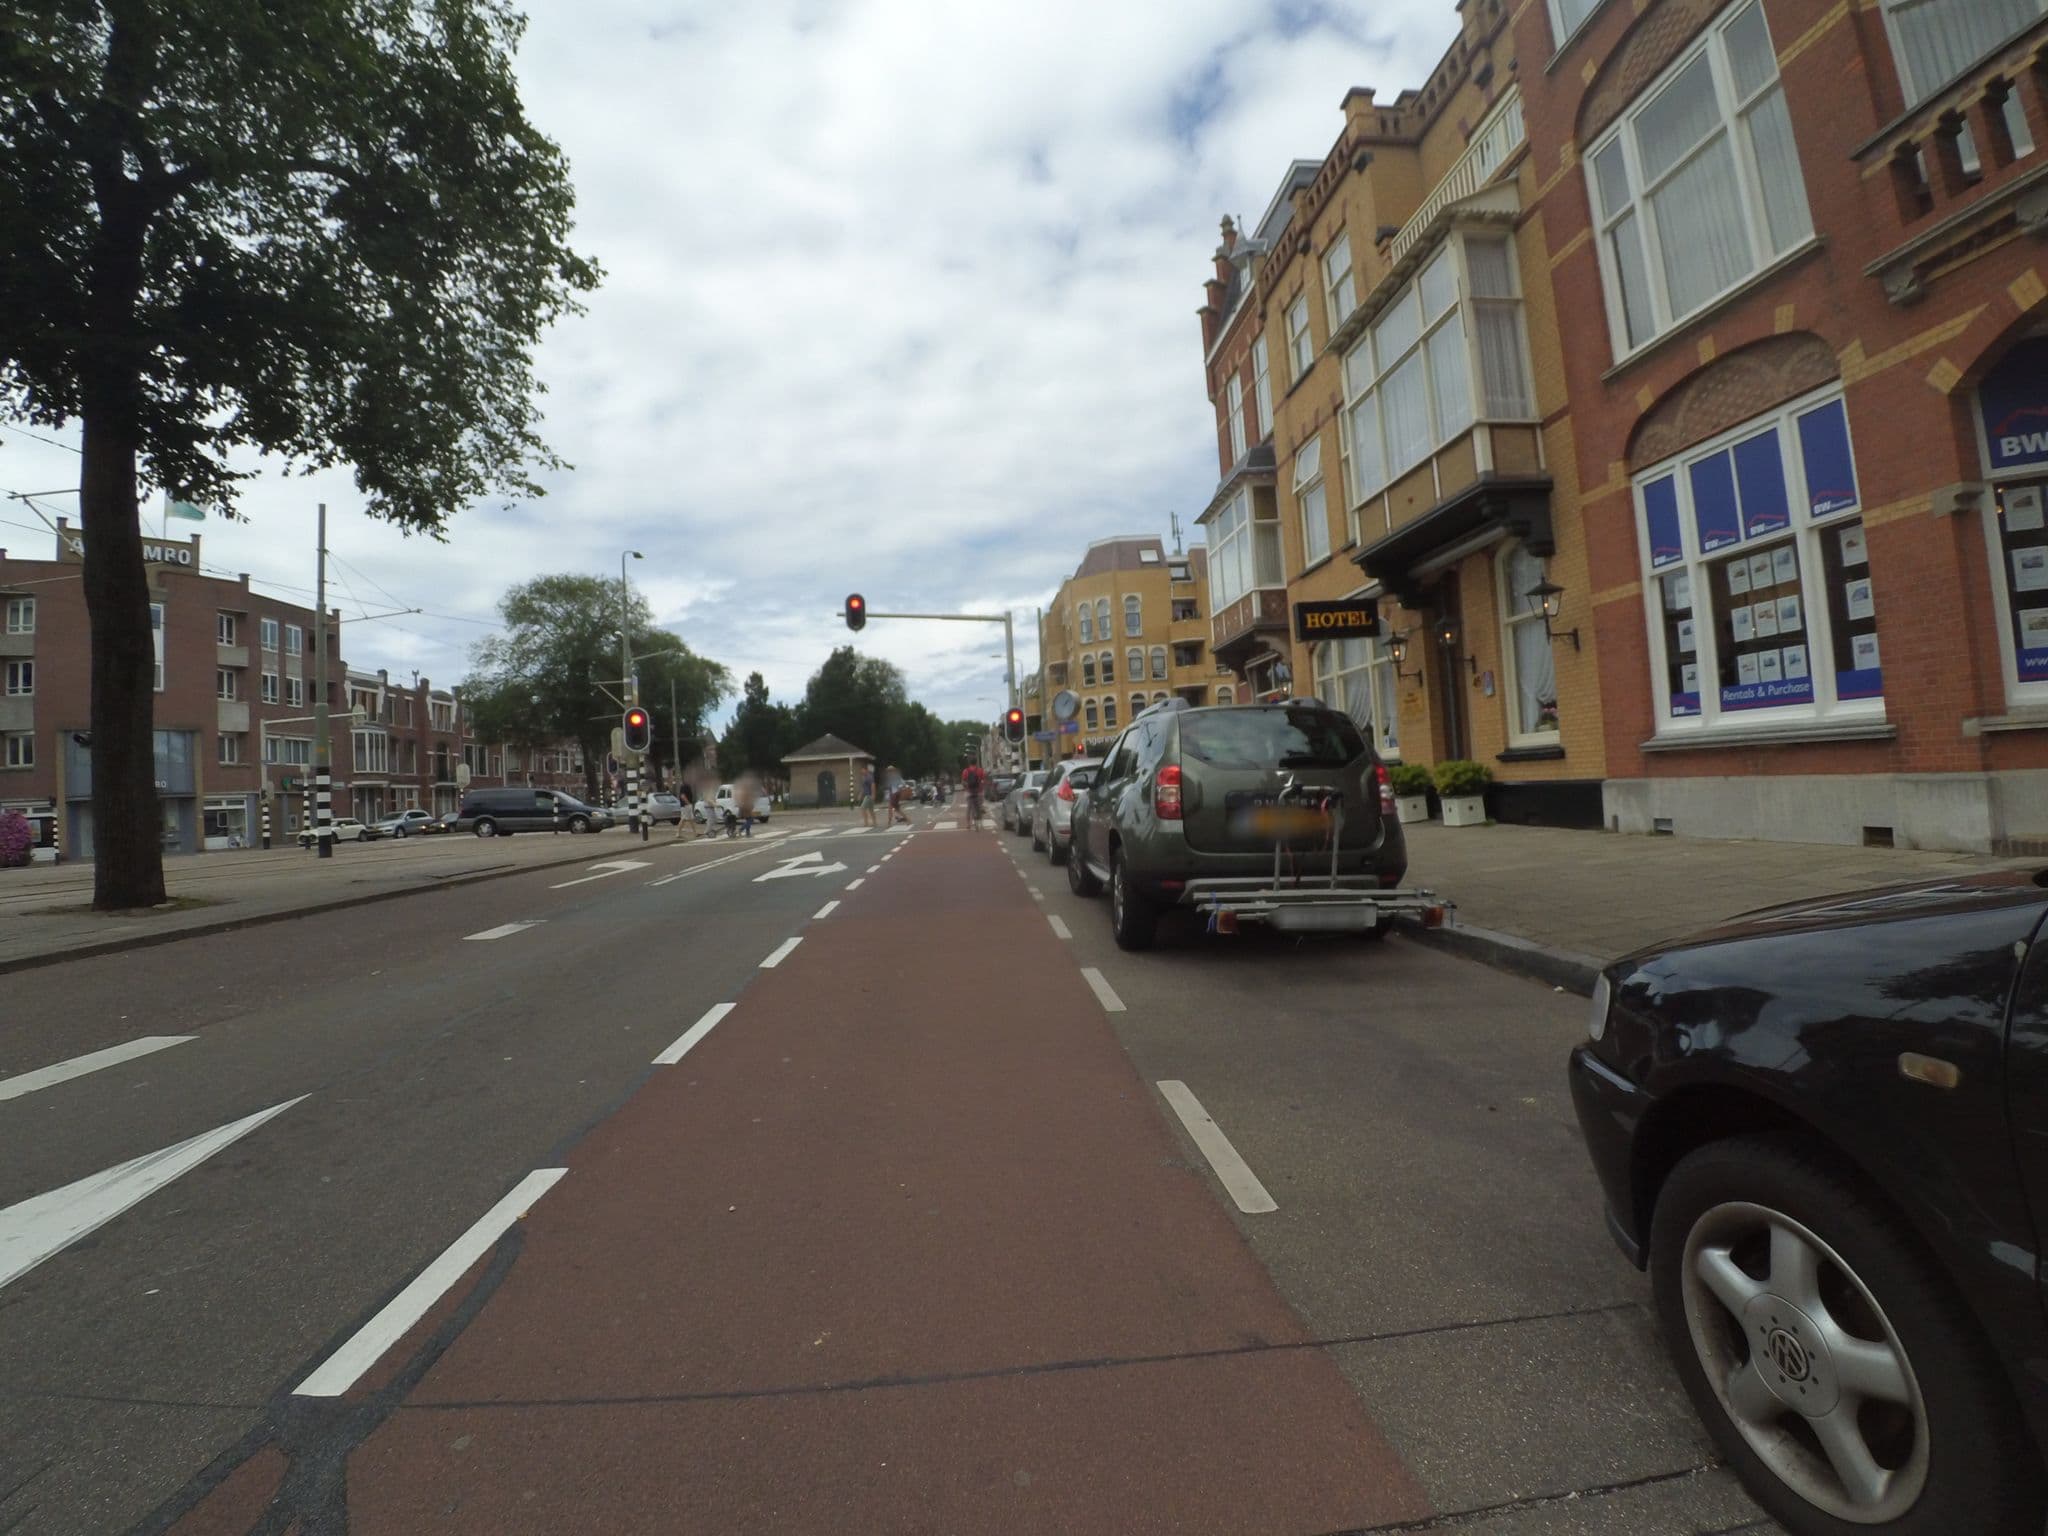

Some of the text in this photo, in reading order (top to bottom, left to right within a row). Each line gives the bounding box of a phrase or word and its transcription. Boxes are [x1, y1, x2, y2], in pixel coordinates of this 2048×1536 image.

[143, 544, 191, 565] MRO
[1305, 610, 1373, 629] HOTEL
[1722, 682, 1810, 700] Rentals & Purchase
